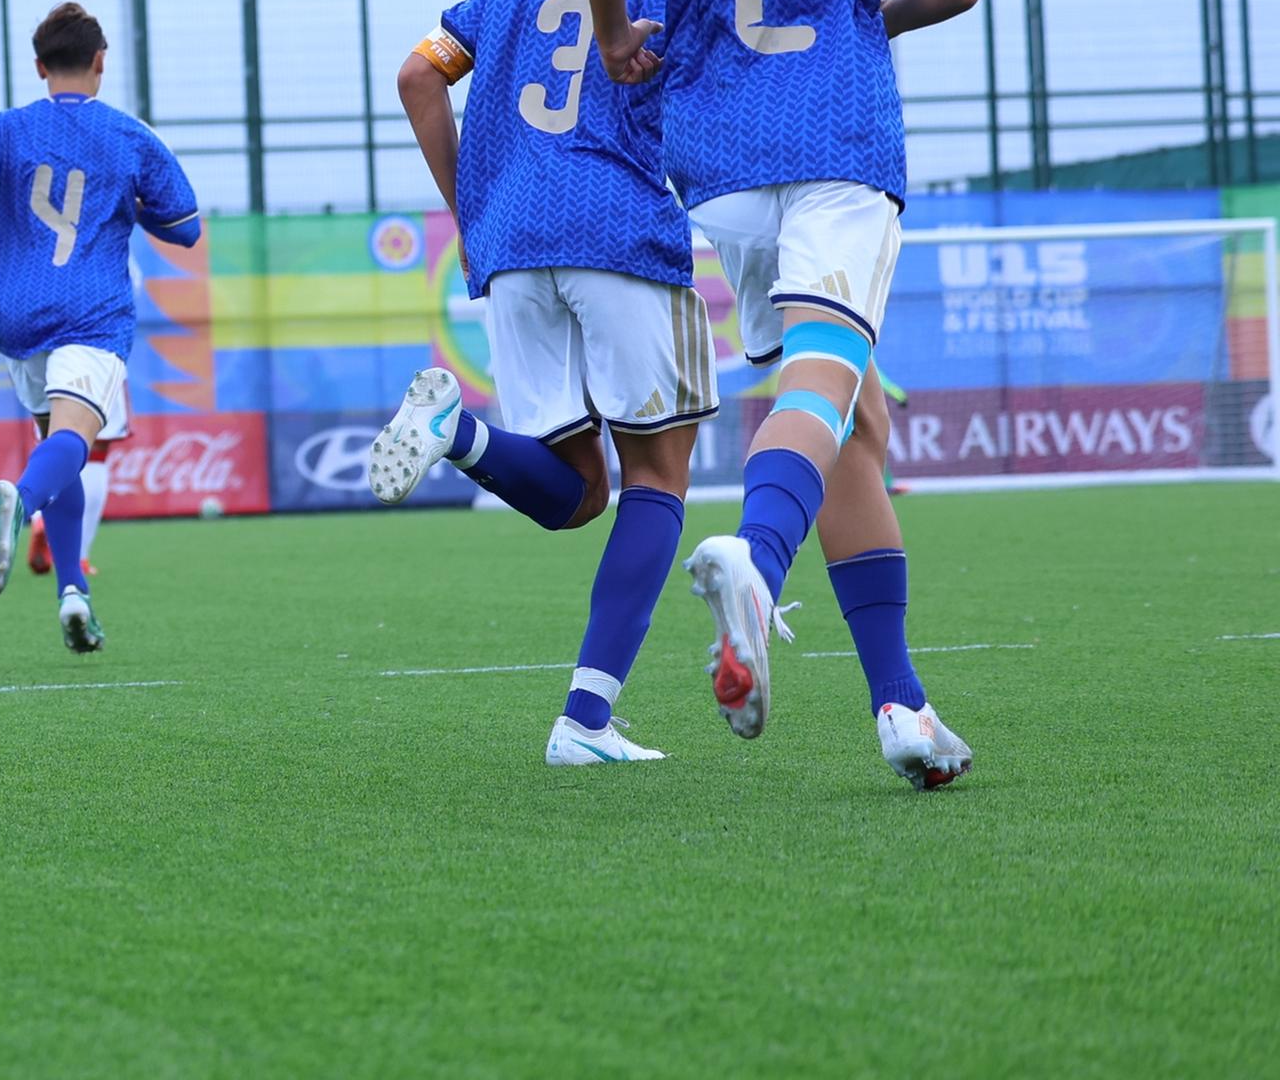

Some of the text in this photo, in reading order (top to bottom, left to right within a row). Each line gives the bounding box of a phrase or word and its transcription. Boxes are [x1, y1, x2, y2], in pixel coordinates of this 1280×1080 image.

[430, 43, 451, 65] FIFA
[30, 164, 85, 267] 4
[938, 241, 1087, 287] U15
[958, 405, 1194, 460] AIRWAYS
